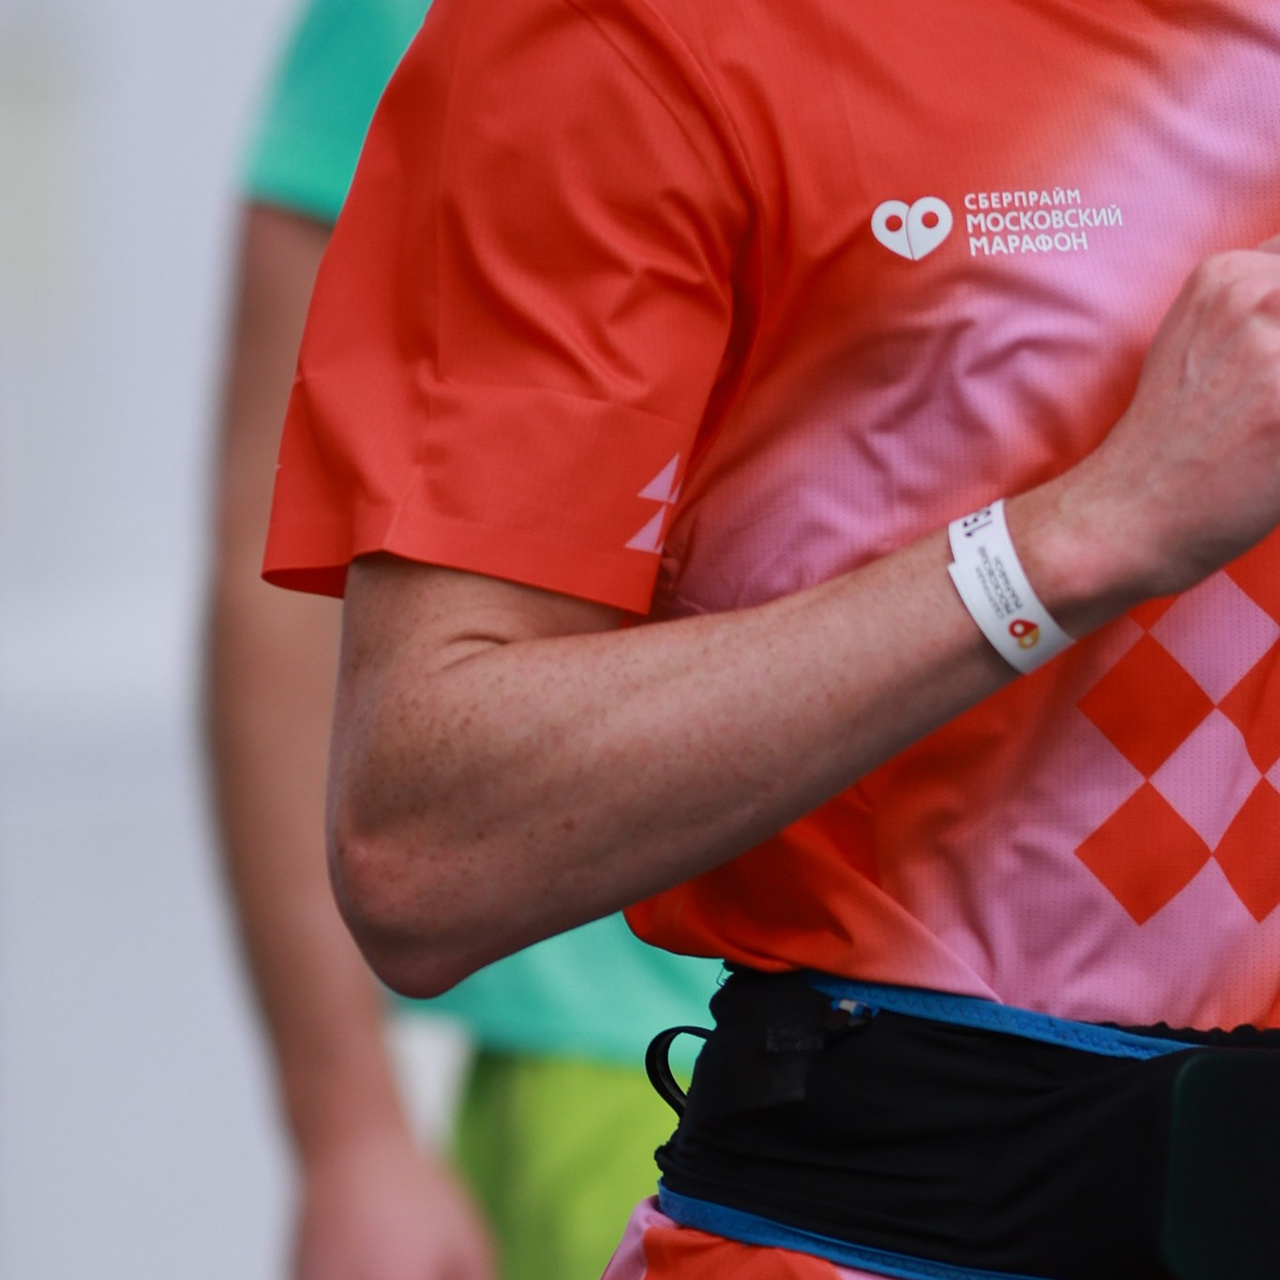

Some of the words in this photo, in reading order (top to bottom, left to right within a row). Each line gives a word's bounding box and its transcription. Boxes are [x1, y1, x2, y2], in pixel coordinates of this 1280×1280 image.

[964, 186, 1082, 209] СБЕРПРАЙМ
[966, 205, 1123, 233] МОСКОВСКИЙ
[969, 232, 1088, 256] МАРАФОН
